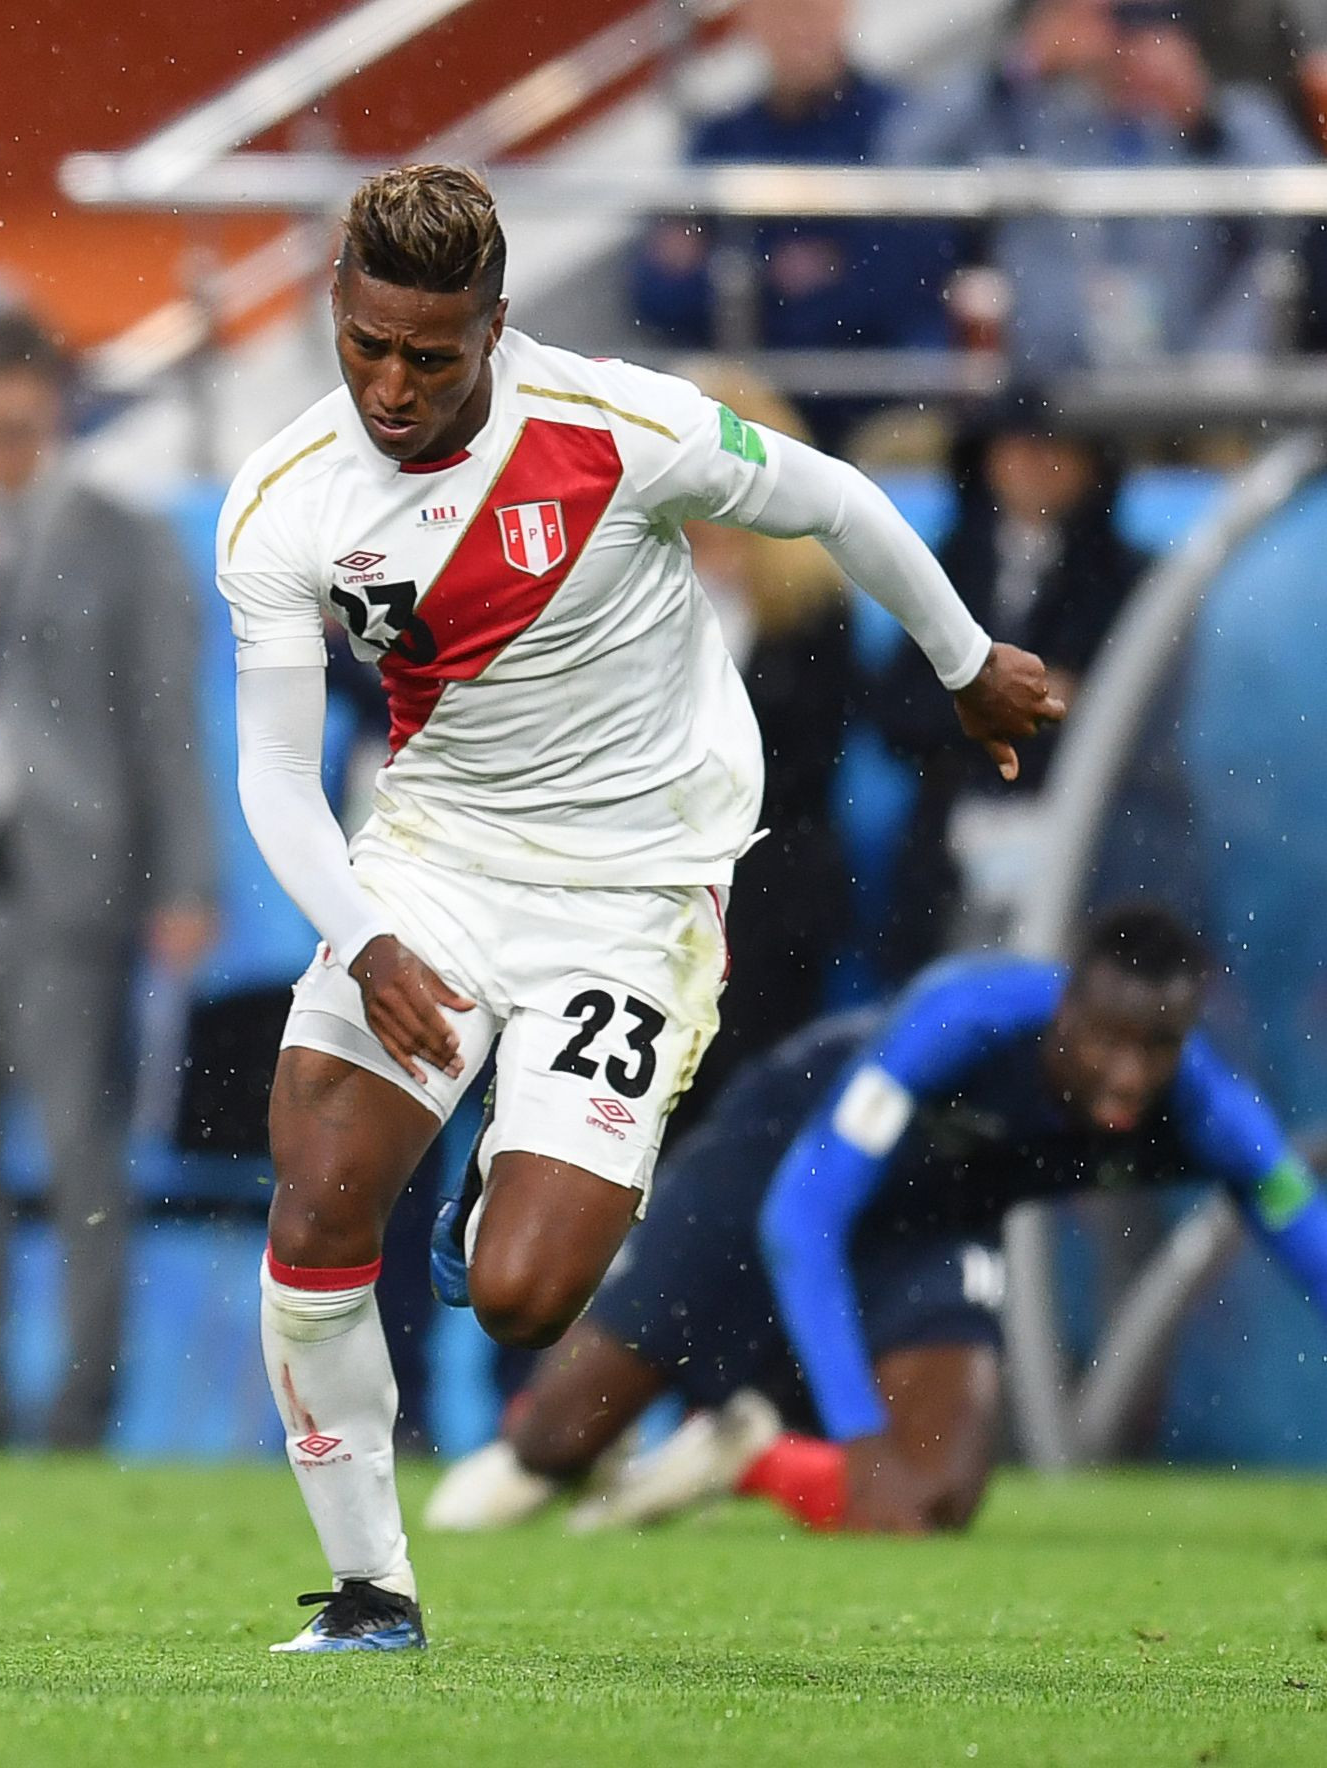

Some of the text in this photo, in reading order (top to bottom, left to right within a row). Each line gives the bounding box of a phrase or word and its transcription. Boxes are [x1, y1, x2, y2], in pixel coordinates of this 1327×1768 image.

[343, 571, 385, 585] umbro
[549, 989, 667, 1099] 23
[585, 1115, 626, 1141] umbro
